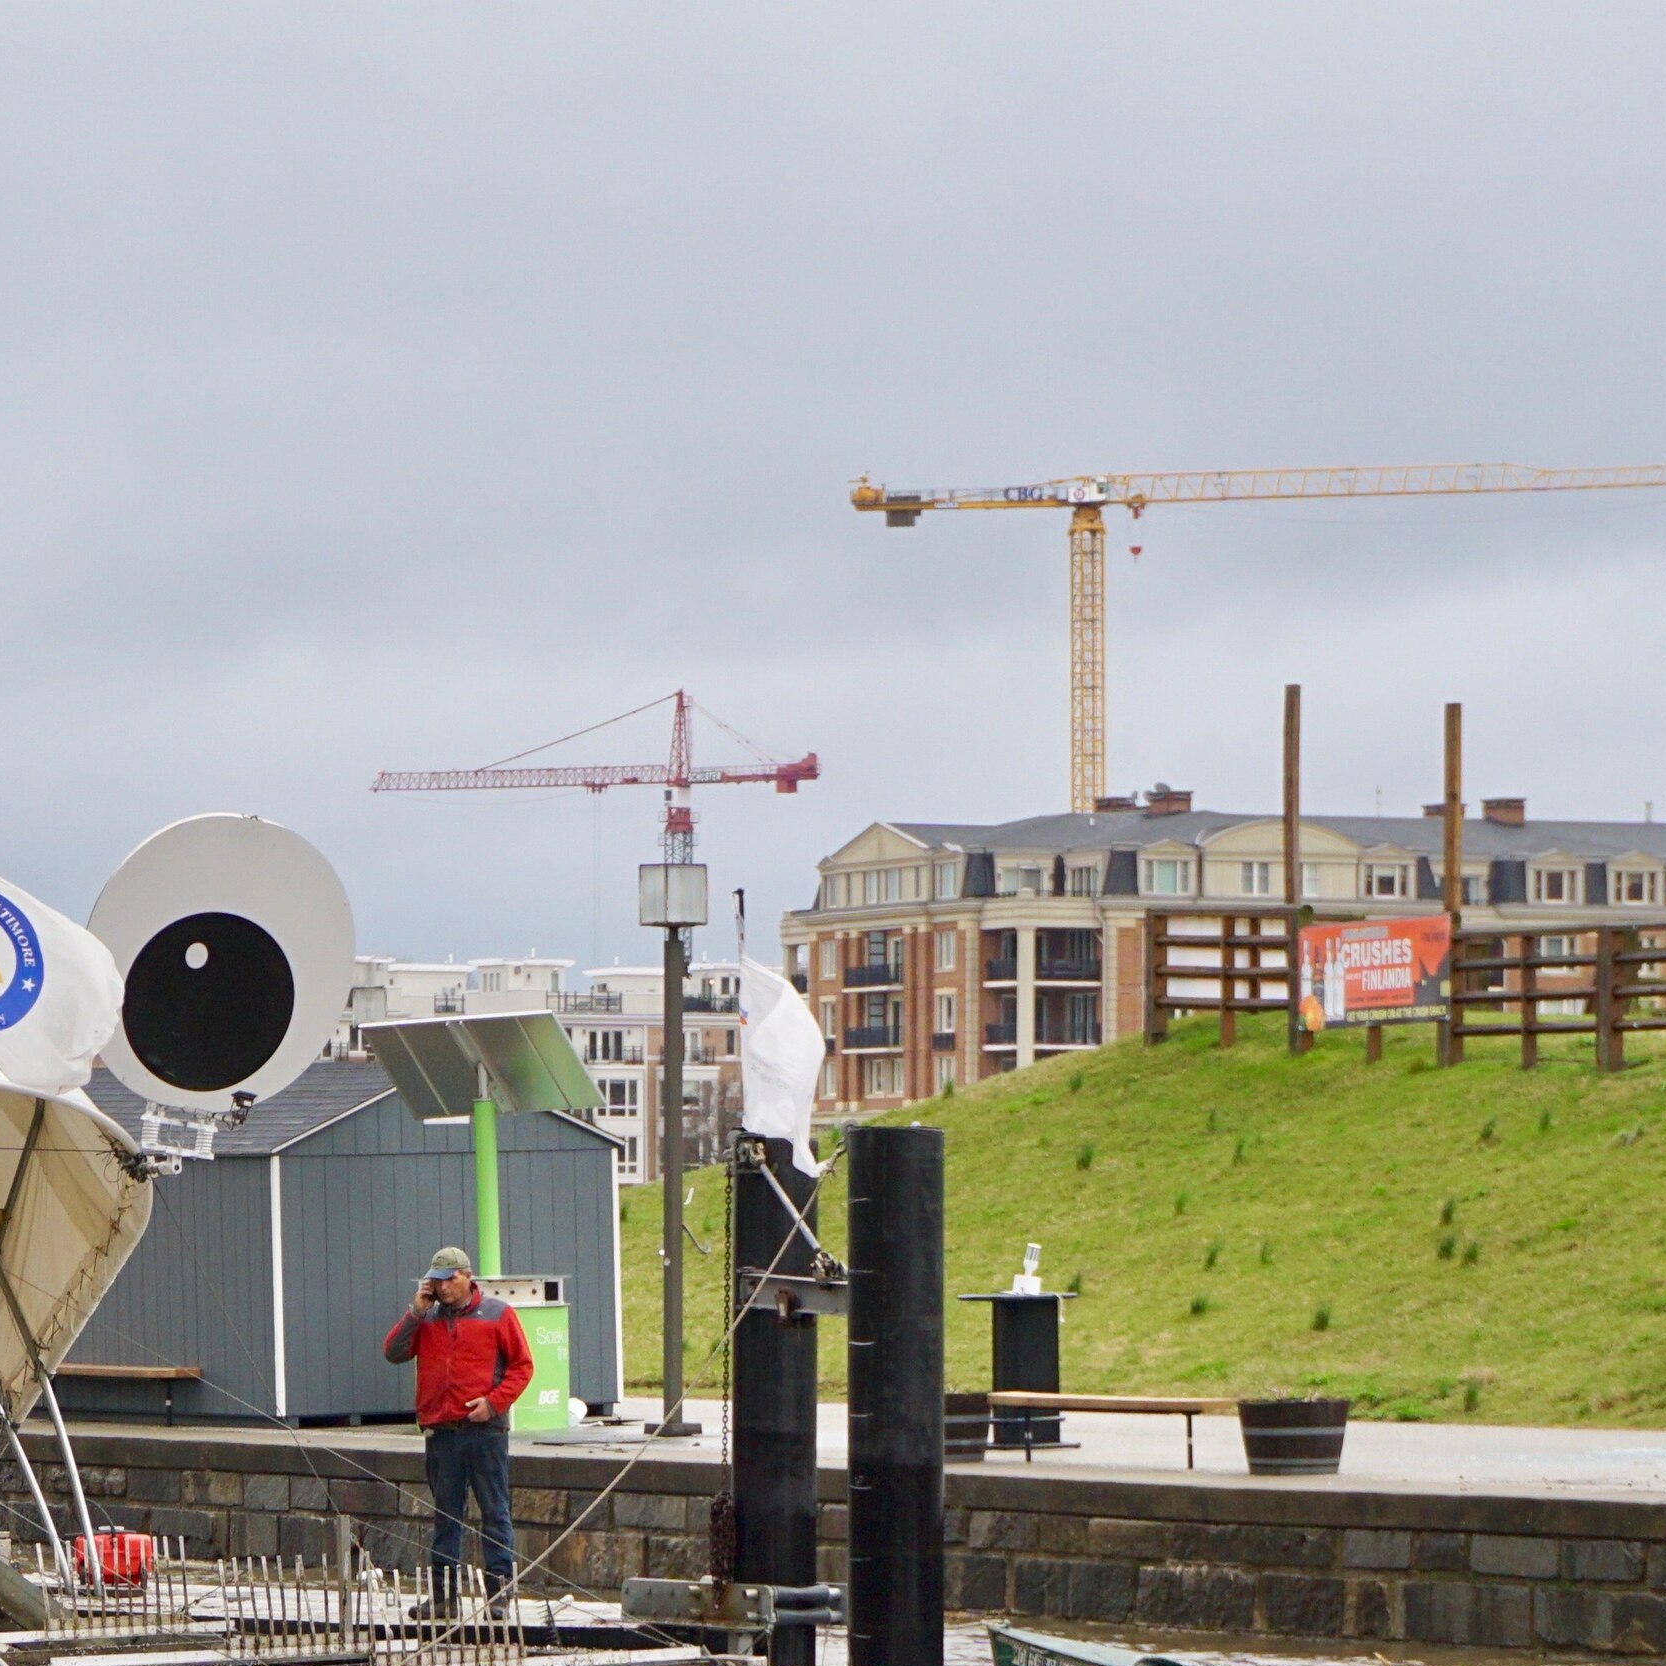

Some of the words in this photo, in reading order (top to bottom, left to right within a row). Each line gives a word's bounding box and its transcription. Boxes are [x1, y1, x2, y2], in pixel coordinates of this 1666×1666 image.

[1341, 938, 1412, 968] CRUSHES
[1362, 967, 1412, 991] FINLANDIA
[538, 1389, 560, 1405] BGE
